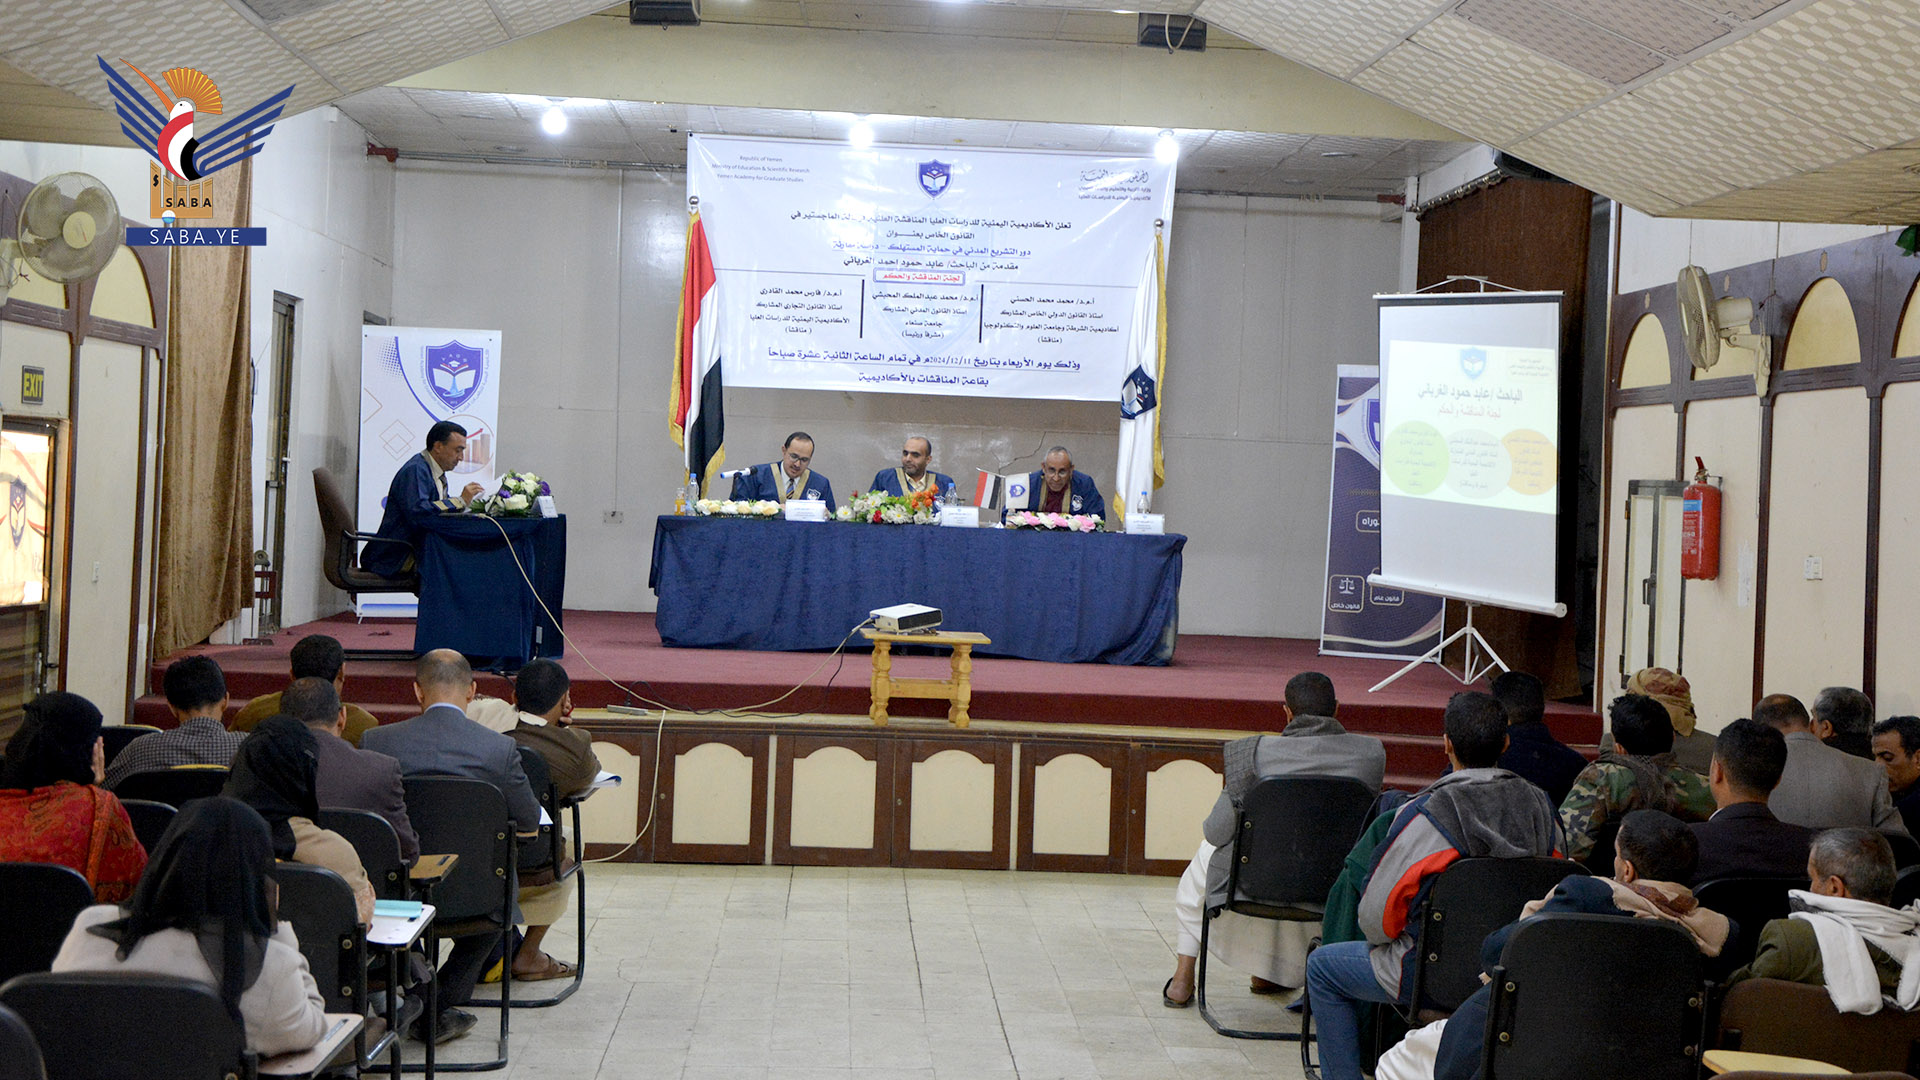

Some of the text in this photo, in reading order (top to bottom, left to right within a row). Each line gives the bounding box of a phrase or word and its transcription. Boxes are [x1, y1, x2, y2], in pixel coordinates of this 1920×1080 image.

[790, 210, 801, 220] في
[803, 211, 840, 220] الماجستير
[894, 215, 927, 223] المناقشة
[929, 217, 947, 226] العليا
[948, 217, 980, 226] للدراسات
[981, 219, 1008, 228] اليمنية
[1010, 219, 1053, 229] الأكاديمية
[1055, 221, 1072, 230] تعلن
[925, 232, 948, 240] الخاص
[888, 243, 924, 252] المستهلك
[925, 244, 950, 254] حماية
[952, 246, 963, 255] في
[964, 247, 989, 256] المدني
[990, 247, 1018, 257] التشريع
[901, 259, 922, 268] حمود
[925, 260, 944, 269] عابد
[979, 261, 990, 270] من
[992, 261, 1019, 270] مقدمة
[883, 272, 961, 282] لجنة المناقشة والحكم
[804, 289, 821, 297] فارس
[1010, 295, 1034, 304] الحسني
[784, 302, 805, 310] التجاري
[806, 303, 826, 311] القانون
[931, 307, 951, 315] القانون
[1000, 309, 1026, 317] المشارك
[1028, 310, 1046, 318] الخاص
[1048, 311, 1066, 319] الدولي
[750, 313, 764, 321] العليا
[765, 314, 791, 322] للدراسات
[924, 320, 943, 328] جامعة
[797, 349, 821, 360] عشرة
[823, 350, 852, 361] الثانية
[854, 351, 885, 361] الساعة
[887, 353, 907, 362] تمام
[908, 353, 921, 366] في
[974, 357, 1000, 367] بتاريخ
[1003, 357, 1034, 368] الأربعاء
[1036, 361, 1052, 369] يوم
[1054, 360, 1081, 370] وذلك
[858, 372, 989, 387] بقاعة المناقشات بالأكاديمية
[23, 372, 44, 398] EXIT
[1451, 387, 1472, 400] حمود
[1497, 387, 1523, 404] الباحث
[1487, 407, 1501, 421] لجنة
[1384, 595, 1400, 603] قانون
